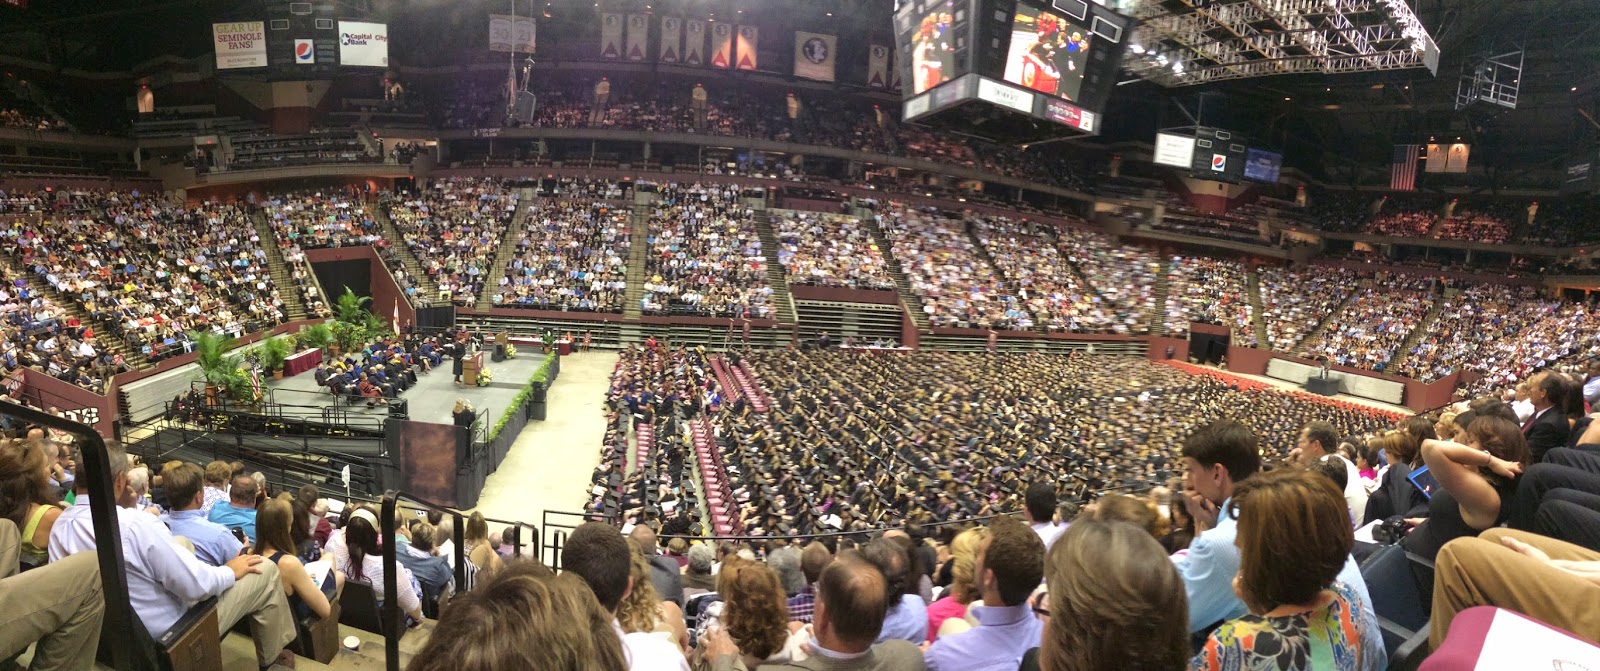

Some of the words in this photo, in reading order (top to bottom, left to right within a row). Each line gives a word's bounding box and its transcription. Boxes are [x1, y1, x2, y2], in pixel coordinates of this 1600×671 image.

[216, 23, 246, 34] GEAR
[247, 22, 262, 32] UP
[217, 32, 262, 43] SEMINOLE
[375, 34, 387, 43] City
[228, 41, 254, 50] FANS!
